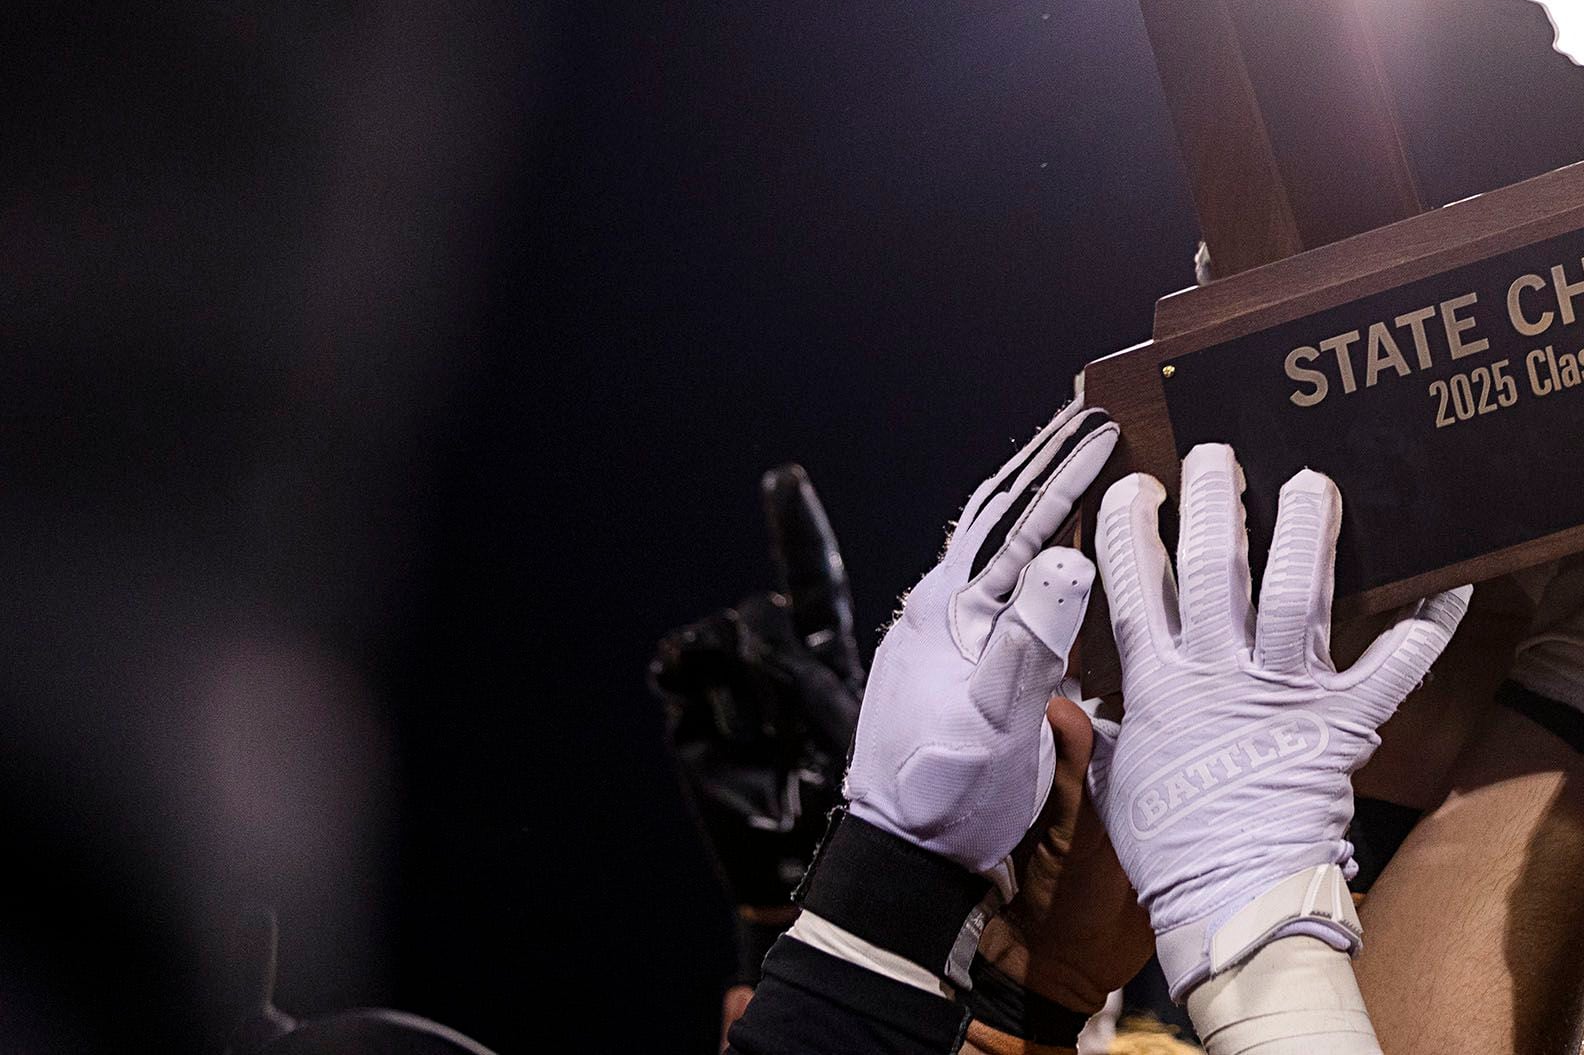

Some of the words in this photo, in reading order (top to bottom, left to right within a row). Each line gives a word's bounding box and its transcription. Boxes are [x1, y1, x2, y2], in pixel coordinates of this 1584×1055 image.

[1283, 291, 1490, 407] STATE
[1428, 359, 1518, 429] 2025
[1136, 720, 1309, 827] BATTLE
